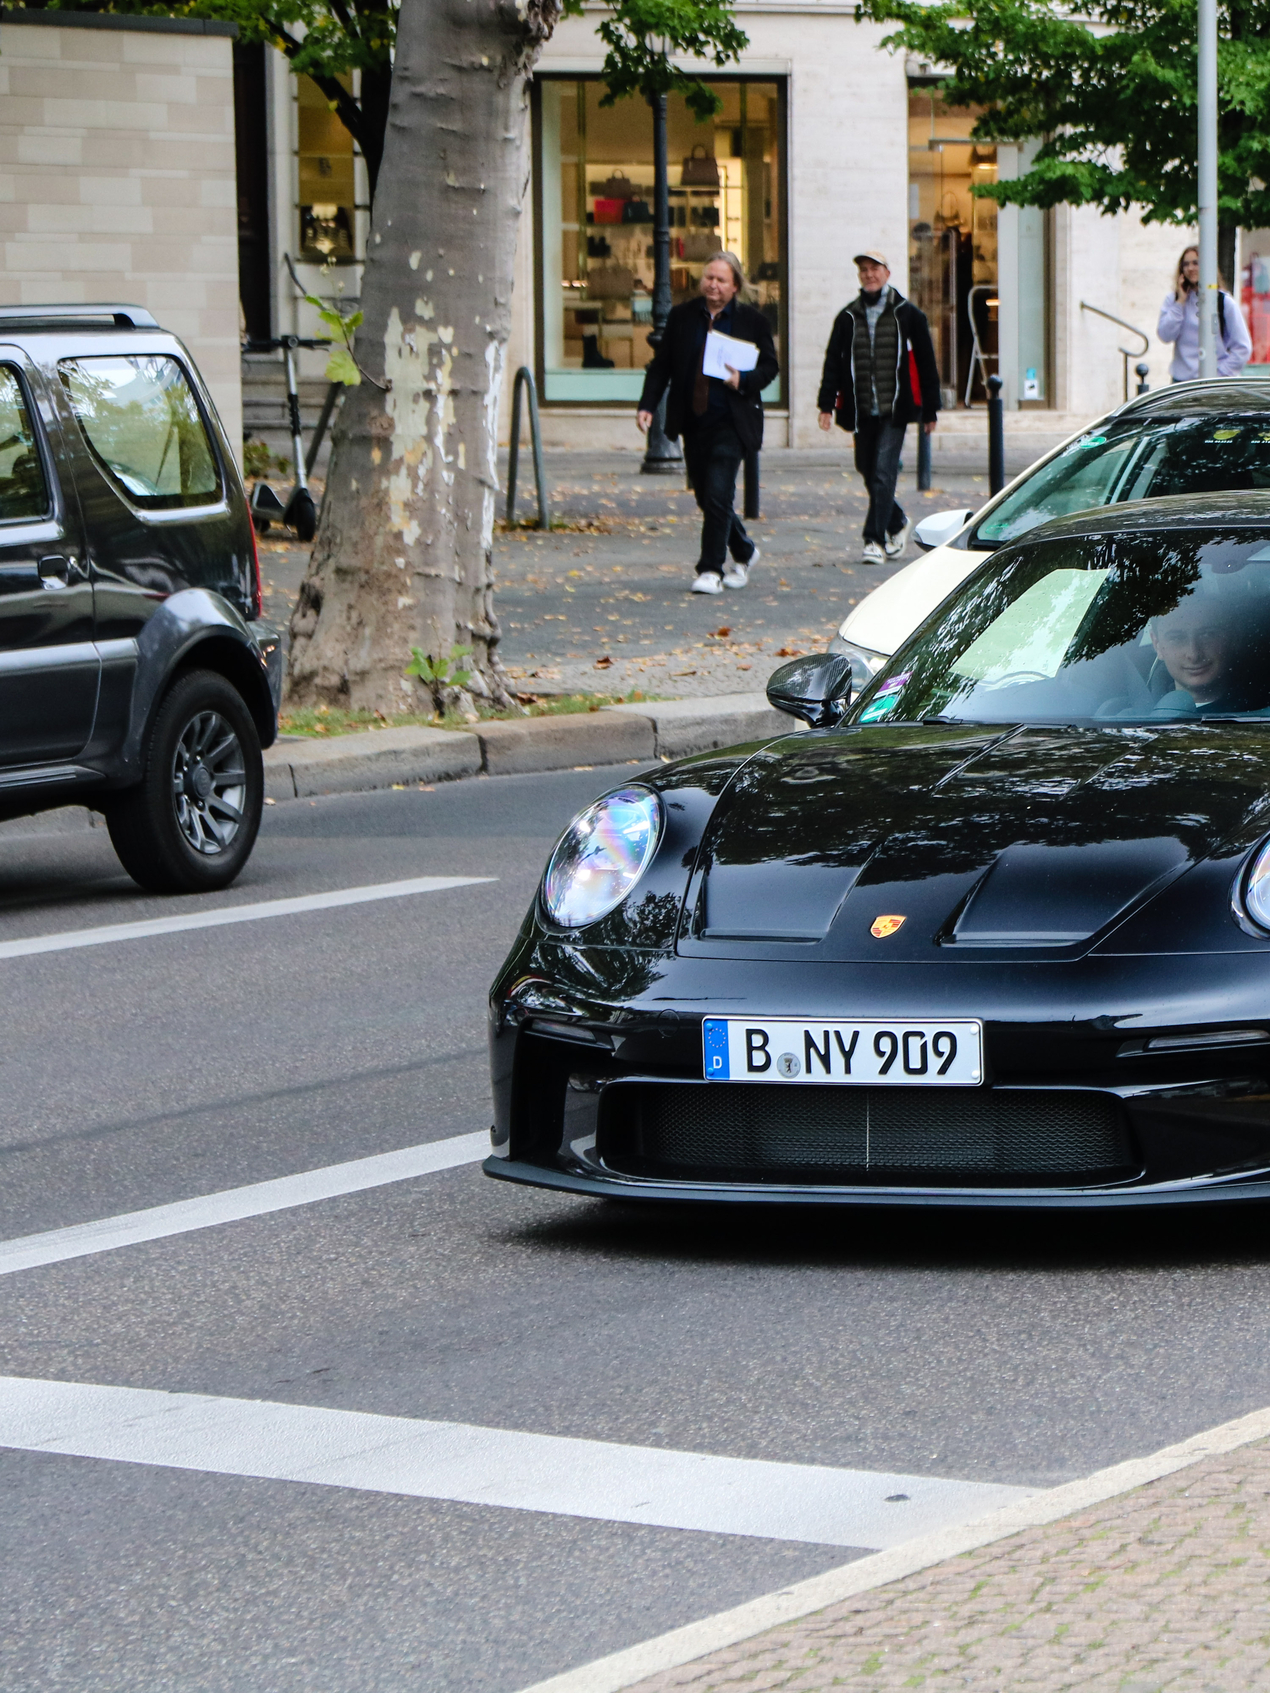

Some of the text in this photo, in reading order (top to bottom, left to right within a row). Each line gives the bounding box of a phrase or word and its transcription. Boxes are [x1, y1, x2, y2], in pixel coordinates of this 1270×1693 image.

[713, 1056, 722, 1069] D
[746, 1028, 772, 1073] B
[804, 1029, 860, 1075] NY
[873, 1031, 958, 1075] 909
